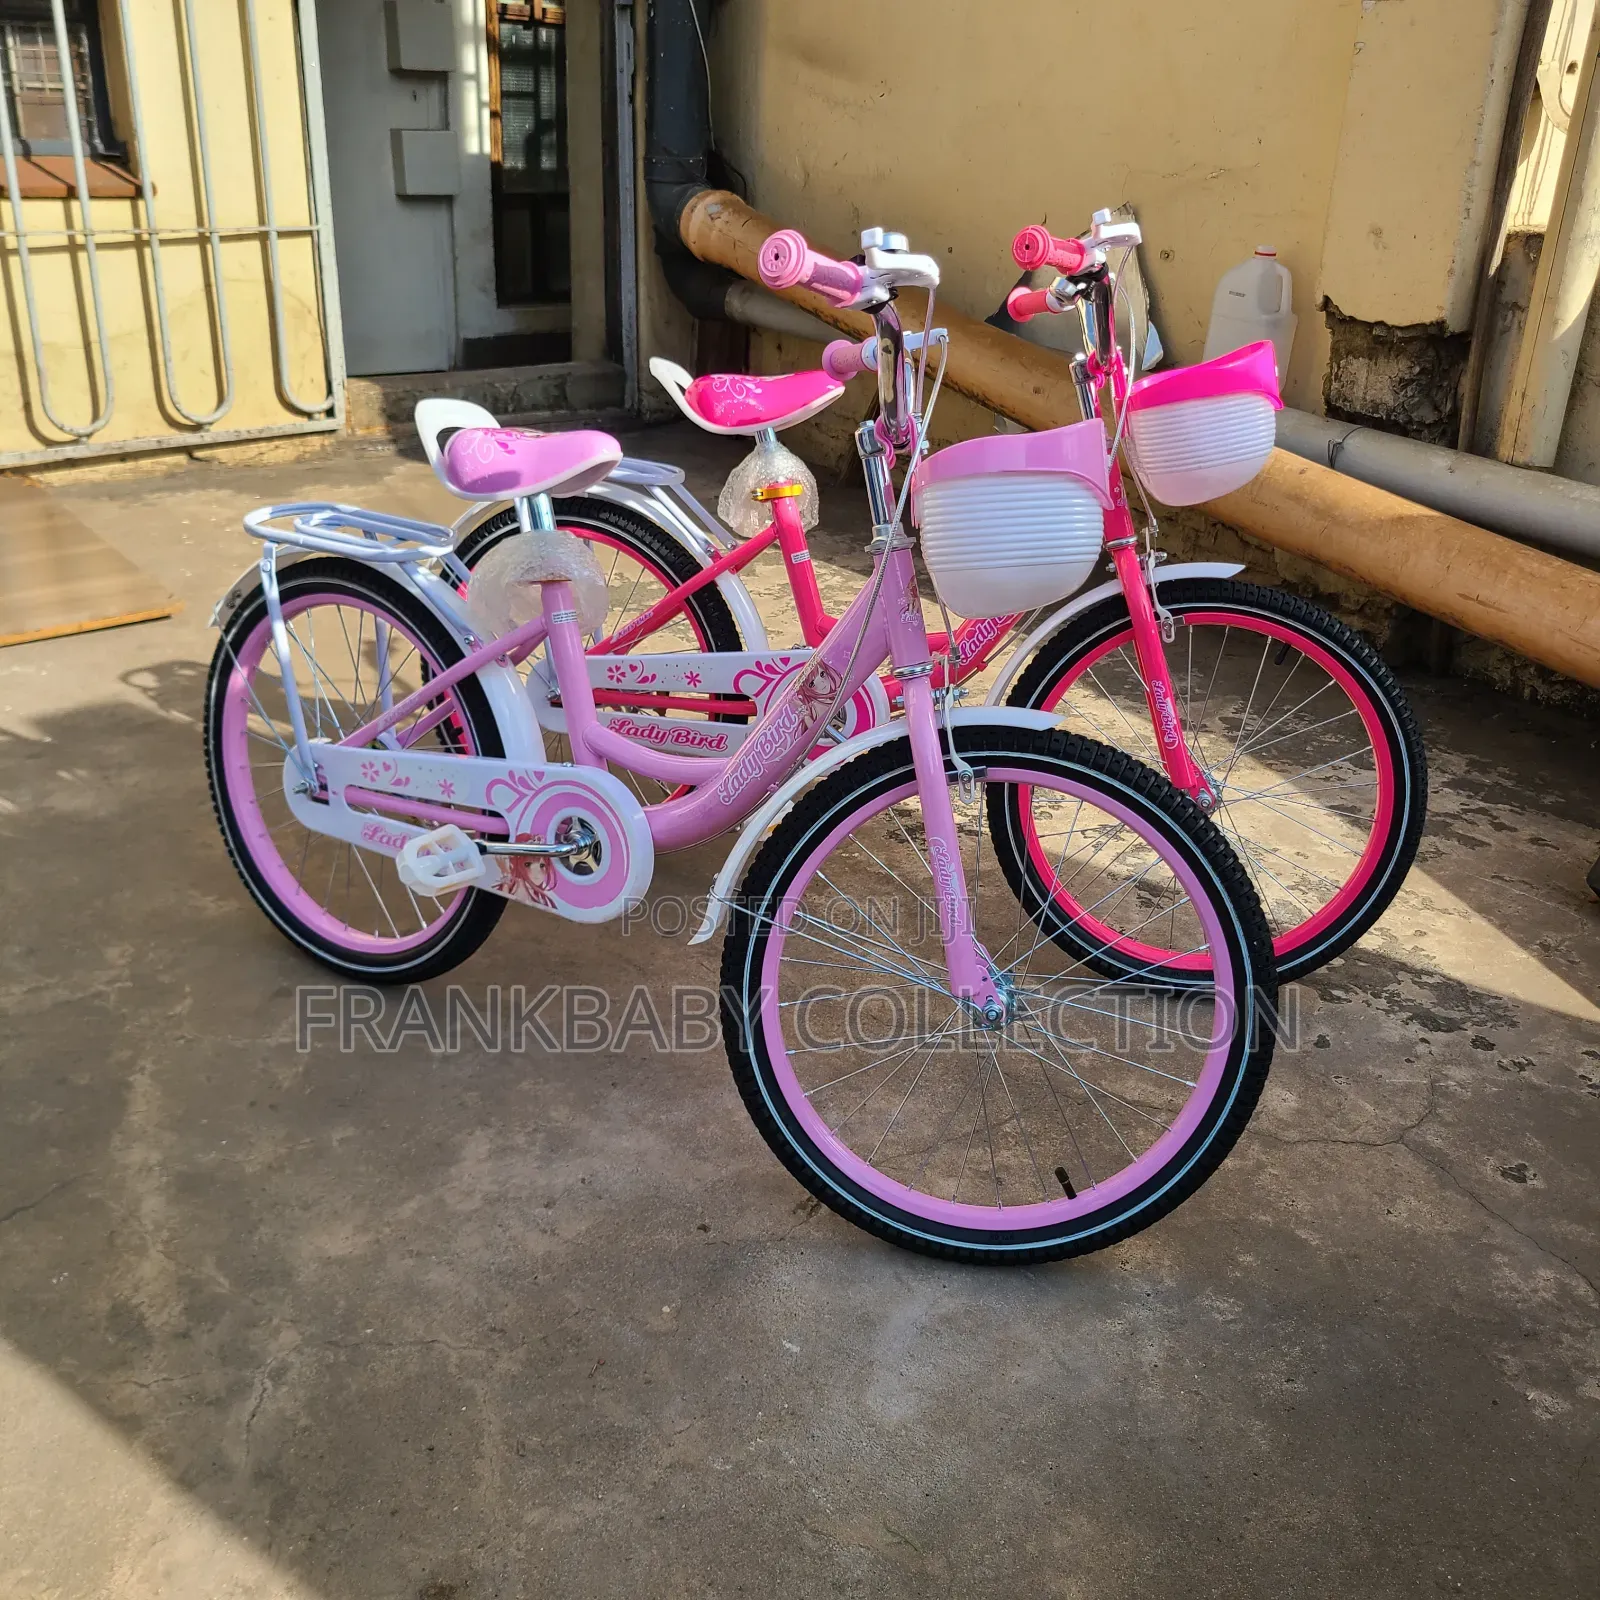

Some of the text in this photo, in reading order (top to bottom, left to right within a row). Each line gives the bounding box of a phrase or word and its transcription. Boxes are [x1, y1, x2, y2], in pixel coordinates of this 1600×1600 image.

[958, 619, 998, 665] Lady
[607, 717, 729, 752] Lady Bird
[1151, 680, 1179, 743] Lady Bird
[717, 703, 798, 805] Lady Bird
[361, 822, 412, 851] Lad
